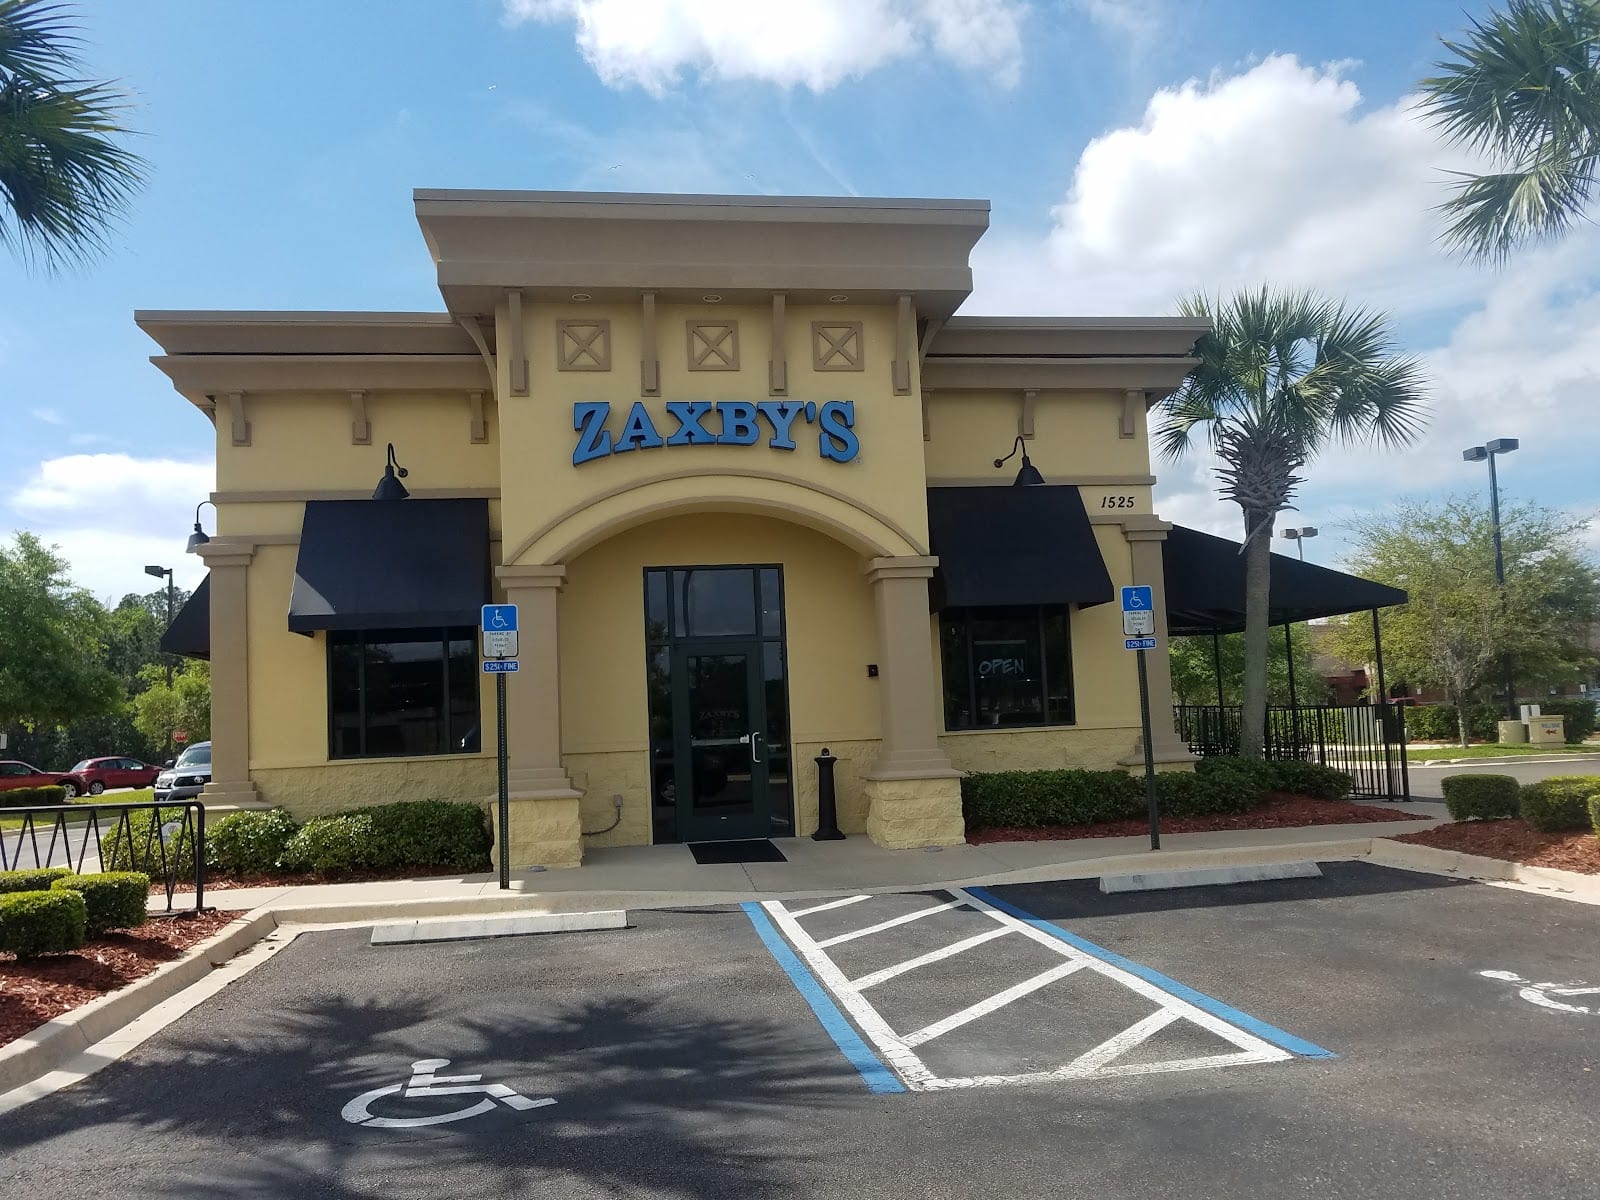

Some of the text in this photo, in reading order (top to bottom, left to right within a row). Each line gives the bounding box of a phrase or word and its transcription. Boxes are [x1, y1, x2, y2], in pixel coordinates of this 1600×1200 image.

[572, 400, 860, 465] ZAXBY'S
[1101, 496, 1136, 509] 1525
[503, 662, 517, 670] FINE
[979, 658, 1024, 675] OPEN
